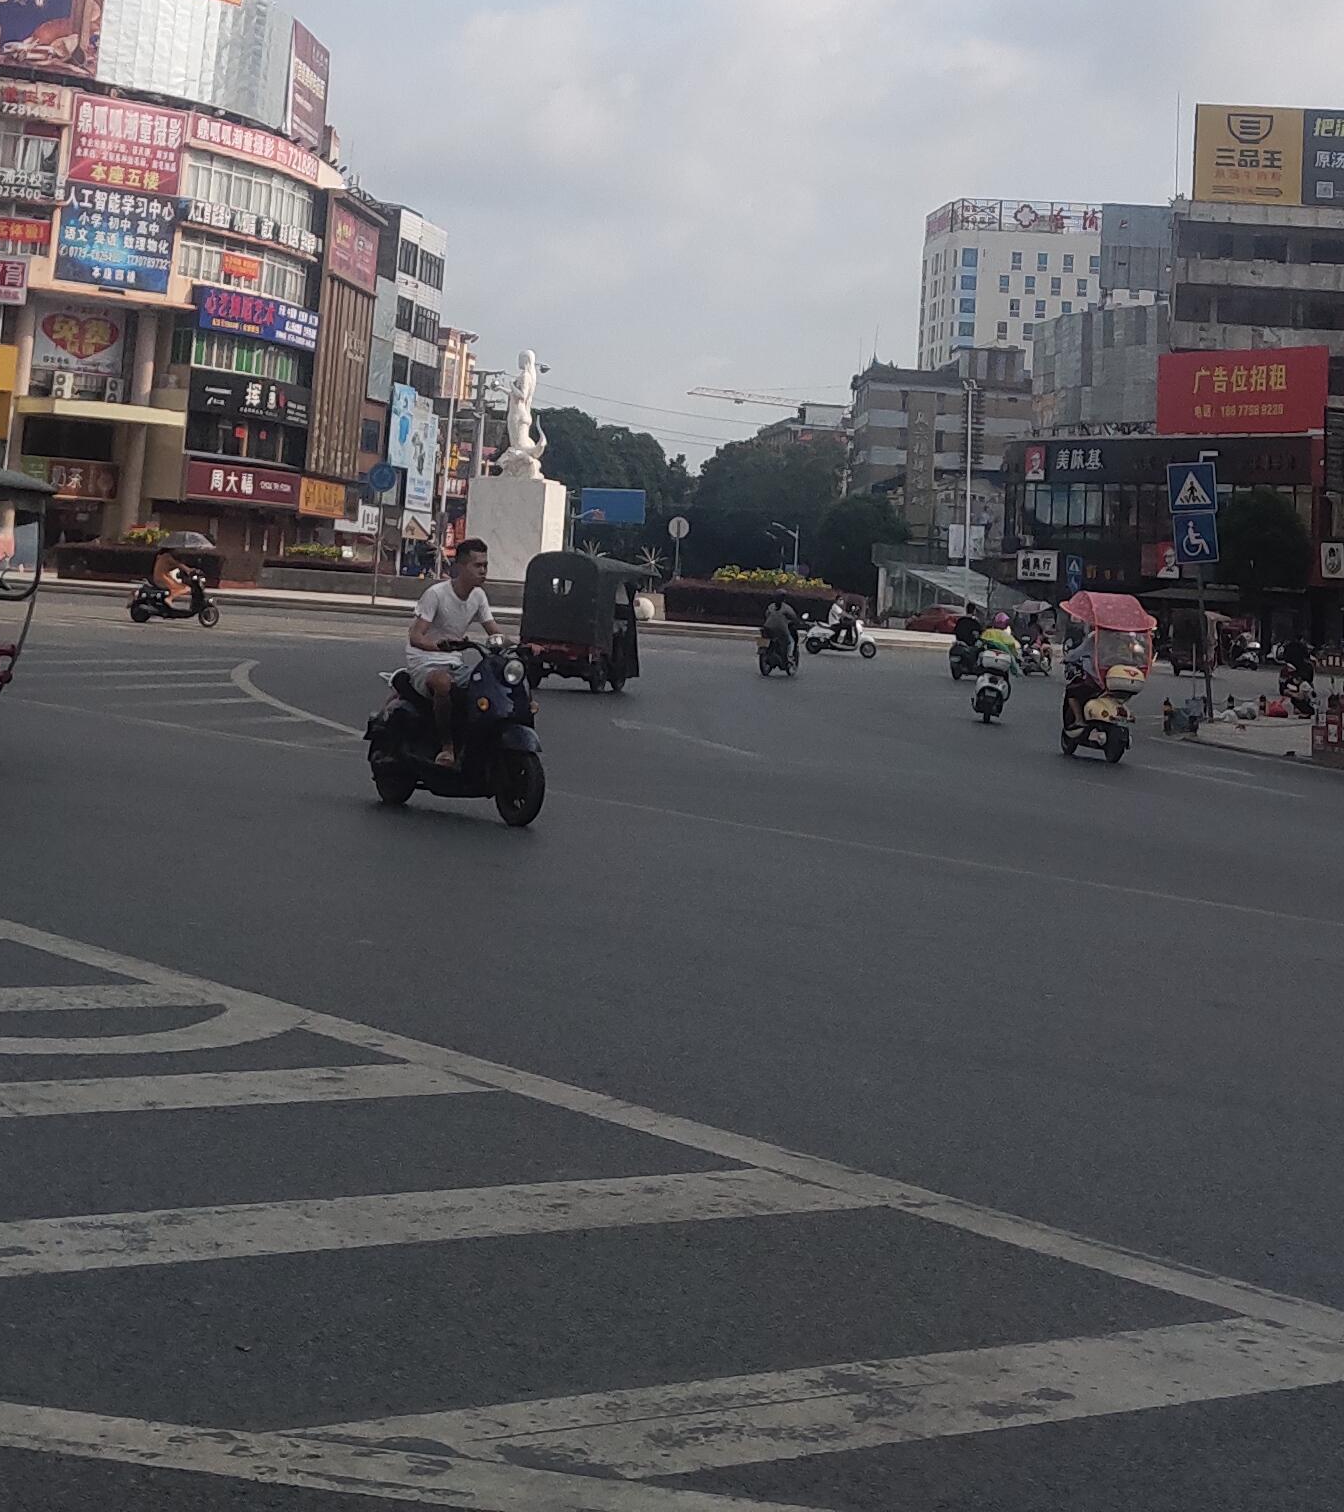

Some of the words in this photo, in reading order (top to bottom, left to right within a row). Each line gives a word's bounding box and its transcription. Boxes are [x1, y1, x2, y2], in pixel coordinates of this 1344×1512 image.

[1215, 147, 1283, 170] 三品王
[65, 185, 175, 222] 人工智能学习中心
[78, 211, 103, 228] 小学
[136, 220, 160, 236] 高中
[1193, 363, 1288, 394] 广告位招租
[1056, 448, 1104, 471] 美味基
[210, 468, 254, 496] 周大福
